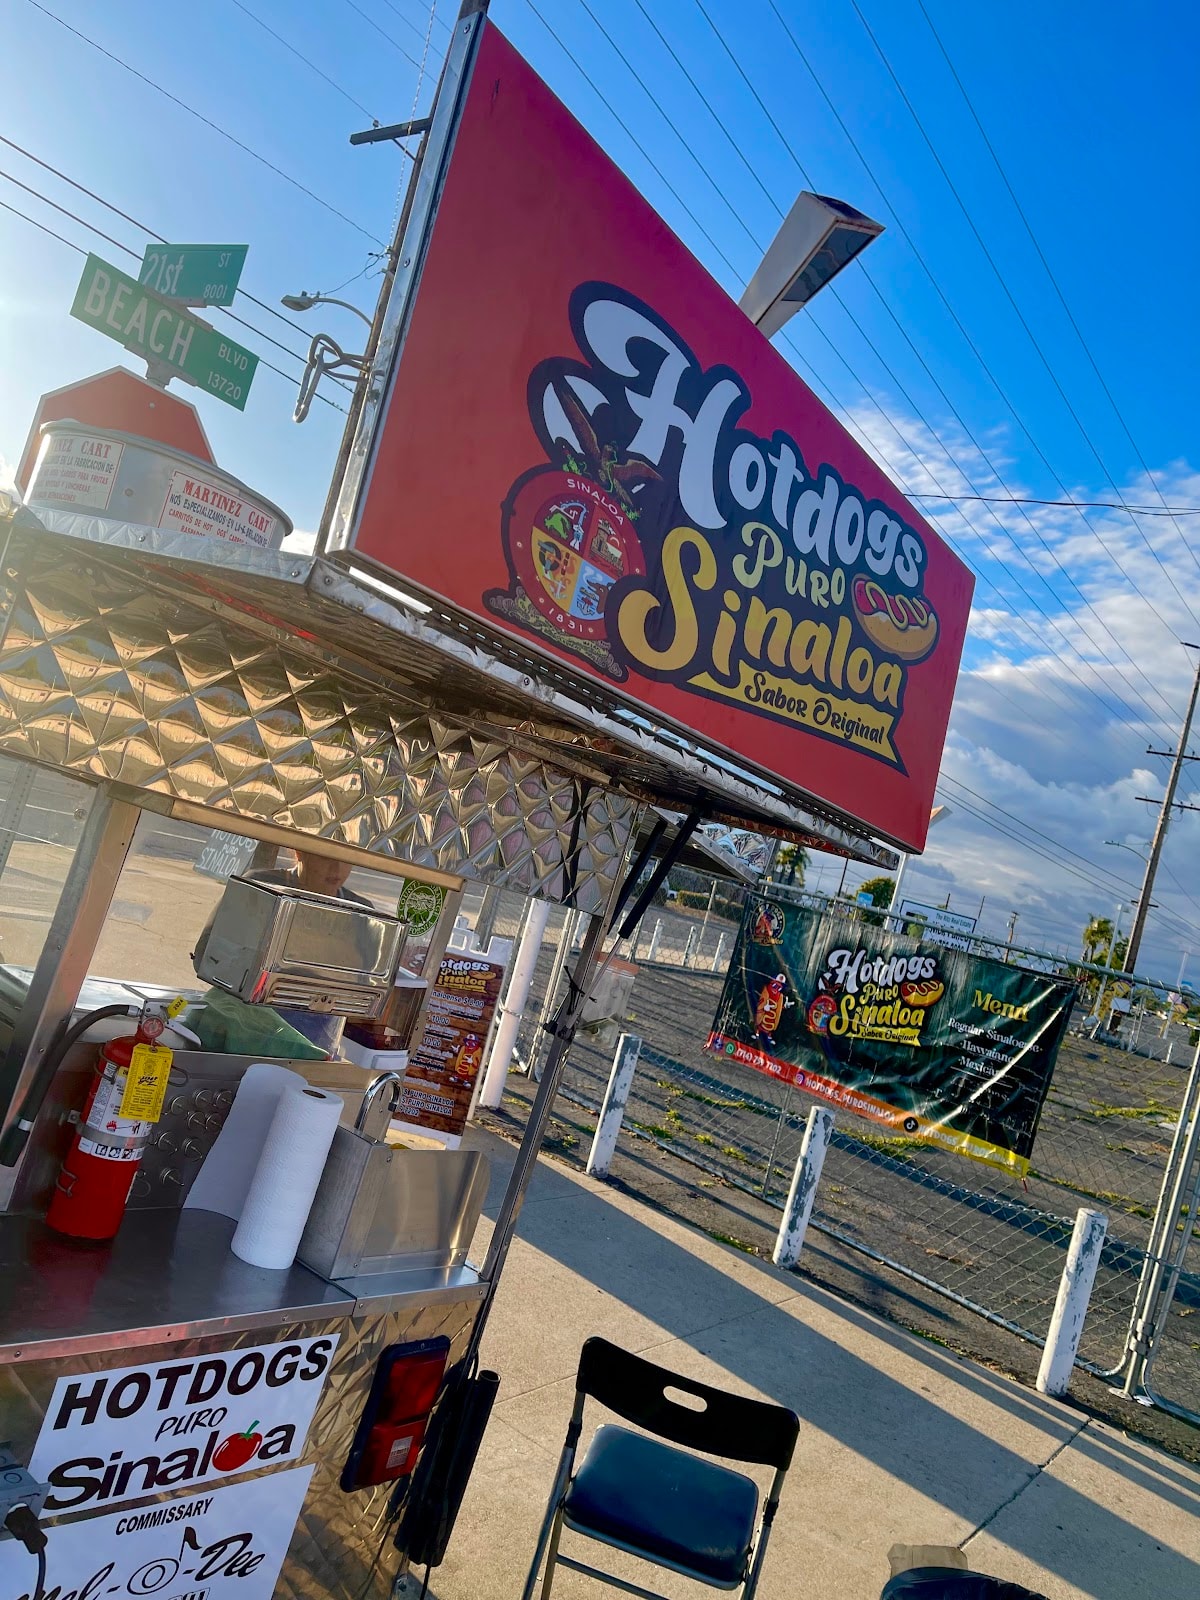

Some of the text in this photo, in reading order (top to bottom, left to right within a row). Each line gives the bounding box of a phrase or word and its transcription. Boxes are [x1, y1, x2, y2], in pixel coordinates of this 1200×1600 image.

[142, 253, 232, 295] 21st ST
[203, 284, 228, 300] 8001
[84, 269, 195, 367] BEACH
[218, 344, 249, 371] BLVD
[207, 371, 242, 402] 13720
[81, 441, 112, 459] CART
[543, 299, 923, 588] Hotdogs
[170, 494, 181, 506] NOS
[184, 499, 227, 525] ESPECIALIZAMOS
[183, 480, 270, 533] MARTINEZ CART
[567, 479, 625, 525] SINALOA
[169, 508, 193, 524] CARRITOS
[194, 519, 202, 528] DE
[217, 528, 226, 540] OGS
[549, 608, 583, 632] 1831
[618, 527, 901, 707] Sinaloa
[196, 847, 240, 876] SINALOA
[440, 959, 490, 972] otdogs
[818, 949, 936, 993] Hotdogs
[432, 990, 461, 1003] naloense
[438, 976, 487, 987] inaloa
[829, 994, 925, 1035] Sinaloa
[986, 1030, 1040, 1053] Sinaloese
[425, 1104, 453, 1115] SINALOA
[428, 1094, 455, 1107] SINALOA
[53, 1339, 333, 1430] HOTDOGS
[154, 1407, 227, 1442] PURO
[115, 1497, 214, 1536] COMMISSARY
